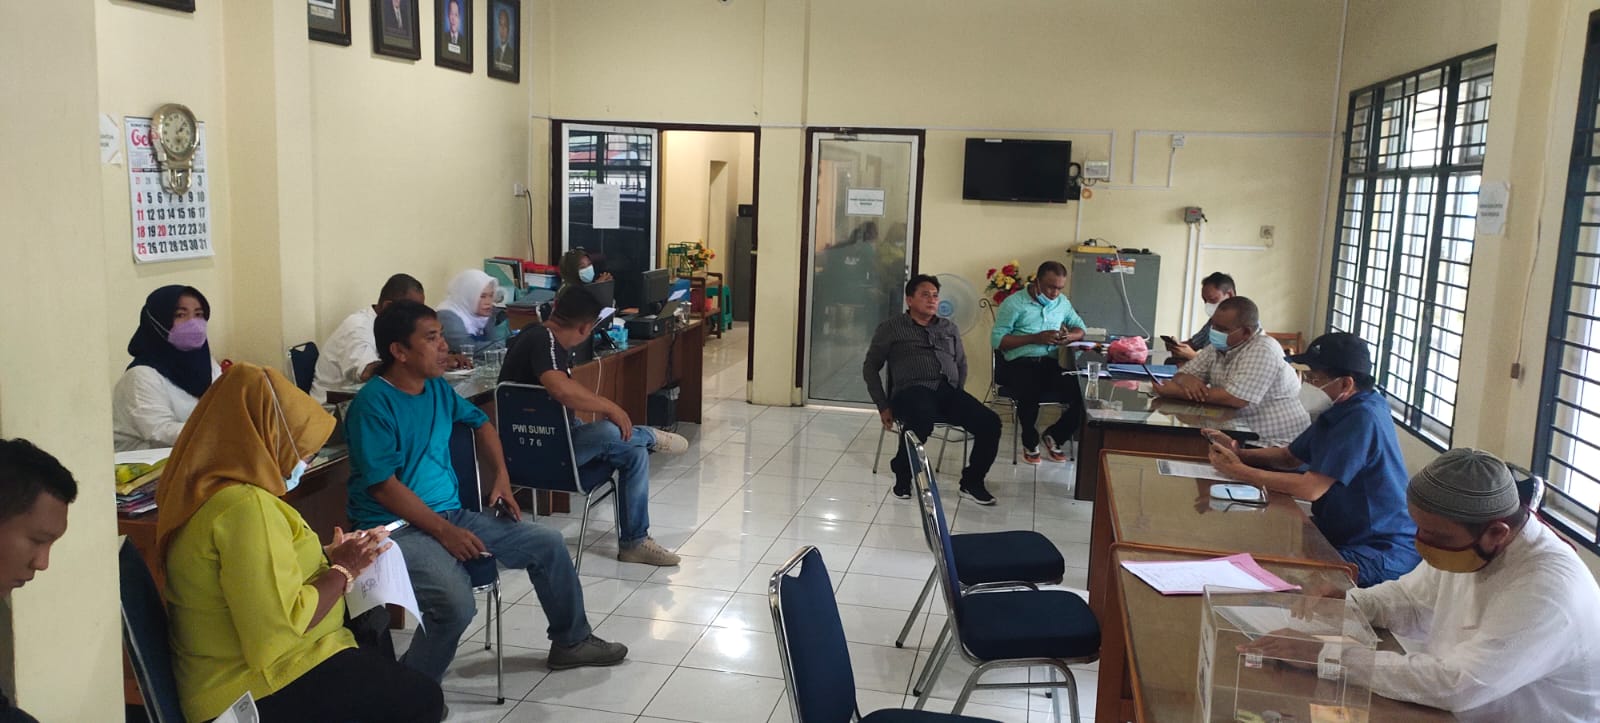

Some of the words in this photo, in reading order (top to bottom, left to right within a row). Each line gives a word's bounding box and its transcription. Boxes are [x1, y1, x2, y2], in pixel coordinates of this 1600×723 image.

[198, 175, 203, 186] 3
[137, 192, 142, 204] 4
[147, 192, 152, 204] 5
[157, 192, 163, 204] 6
[188, 191, 193, 202] 9
[198, 191, 205, 202] 10
[137, 210, 144, 221] 11
[147, 209, 154, 220] 12
[157, 208, 165, 220] 13
[168, 208, 175, 219] 14
[177, 208, 185, 219] 15
[188, 207, 196, 218] 16
[199, 207, 205, 218] 17
[137, 226, 145, 238] 18
[148, 226, 155, 237] 19
[158, 225, 166, 236] 20
[168, 224, 176, 236] 21
[178, 224, 186, 235] 22
[188, 223, 197, 234] 23
[199, 223, 206, 234] 24
[137, 243, 147, 254] 25
[148, 242, 158, 254] 26
[159, 241, 168, 253] 27
[169, 240, 178, 252] 28
[179, 240, 188, 251] 29
[189, 239, 198, 250] 30
[199, 238, 207, 249] 31
[512, 424, 527, 433] PWI
[528, 425, 556, 435] SUMUT
